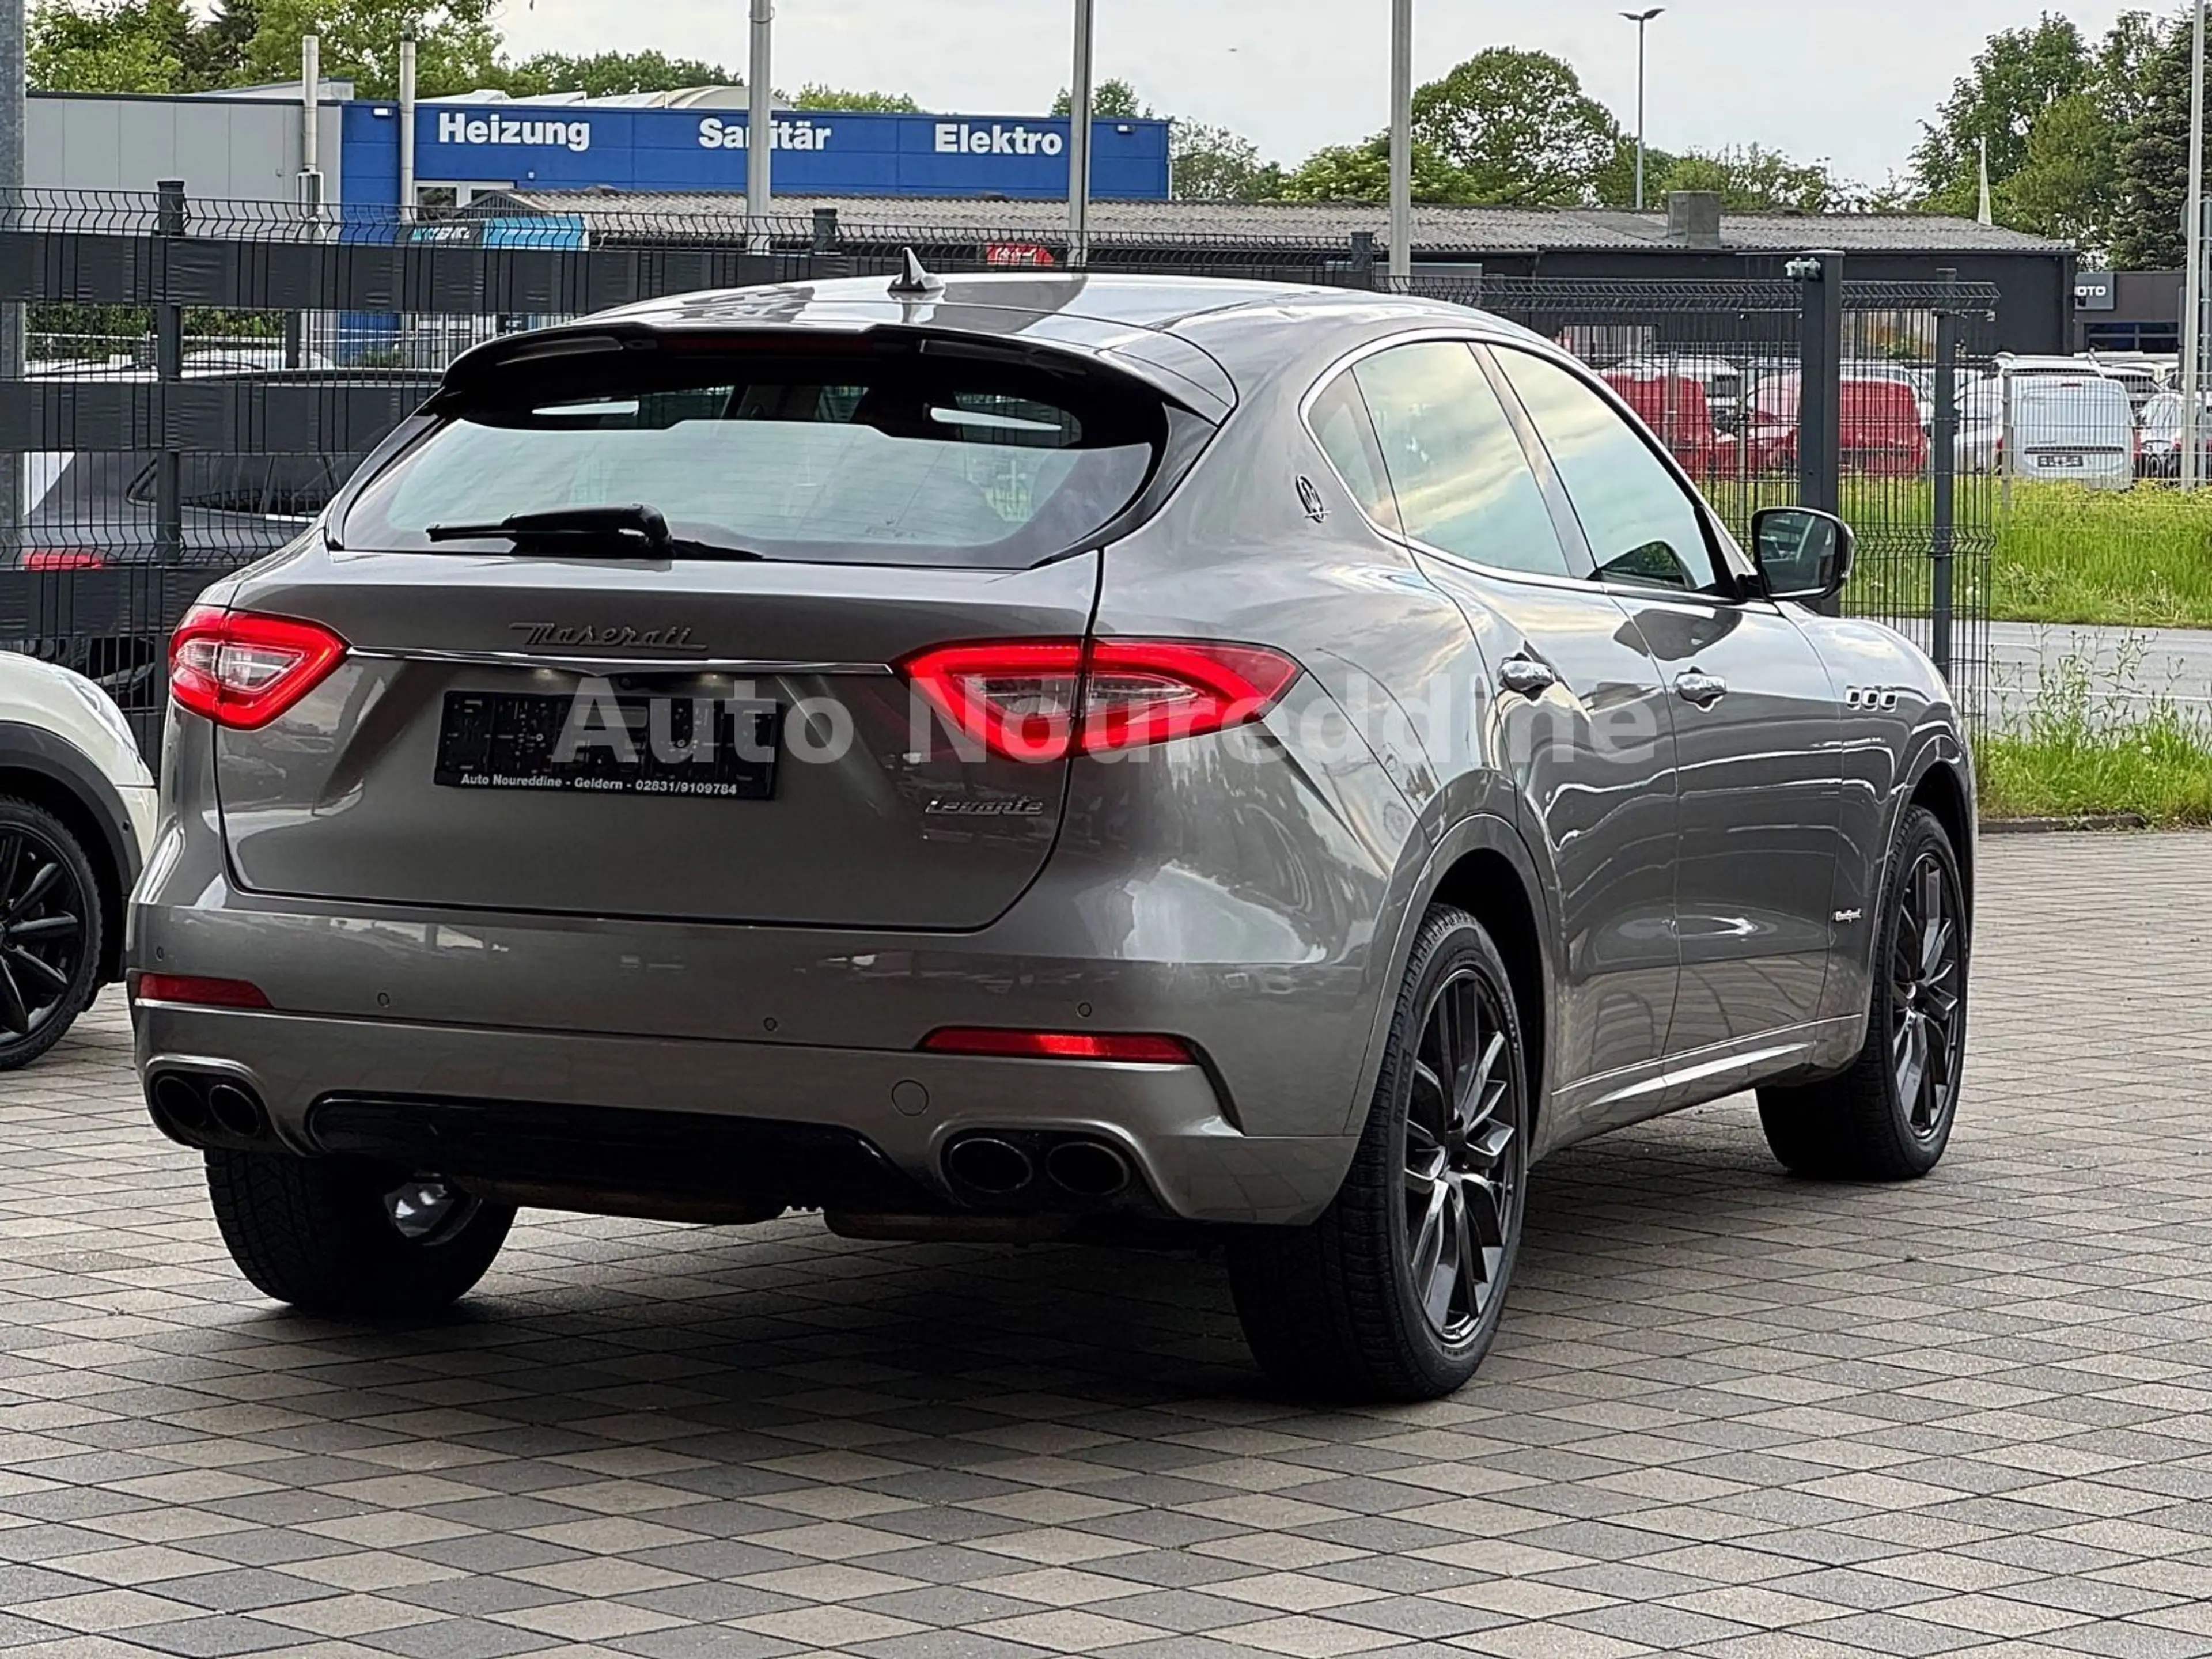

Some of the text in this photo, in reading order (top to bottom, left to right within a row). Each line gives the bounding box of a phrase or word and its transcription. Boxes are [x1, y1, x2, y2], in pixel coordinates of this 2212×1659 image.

[439, 113, 590, 151] Heizung
[935, 123, 1062, 155] Elektro
[2074, 286, 2106, 297] OTO
[509, 622, 707, 651] Maserati
[461, 774, 489, 785] Auto
[493, 774, 562, 787] Noureddine
[574, 777, 623, 790] Geldern
[635, 779, 737, 795] 02831/9109784
